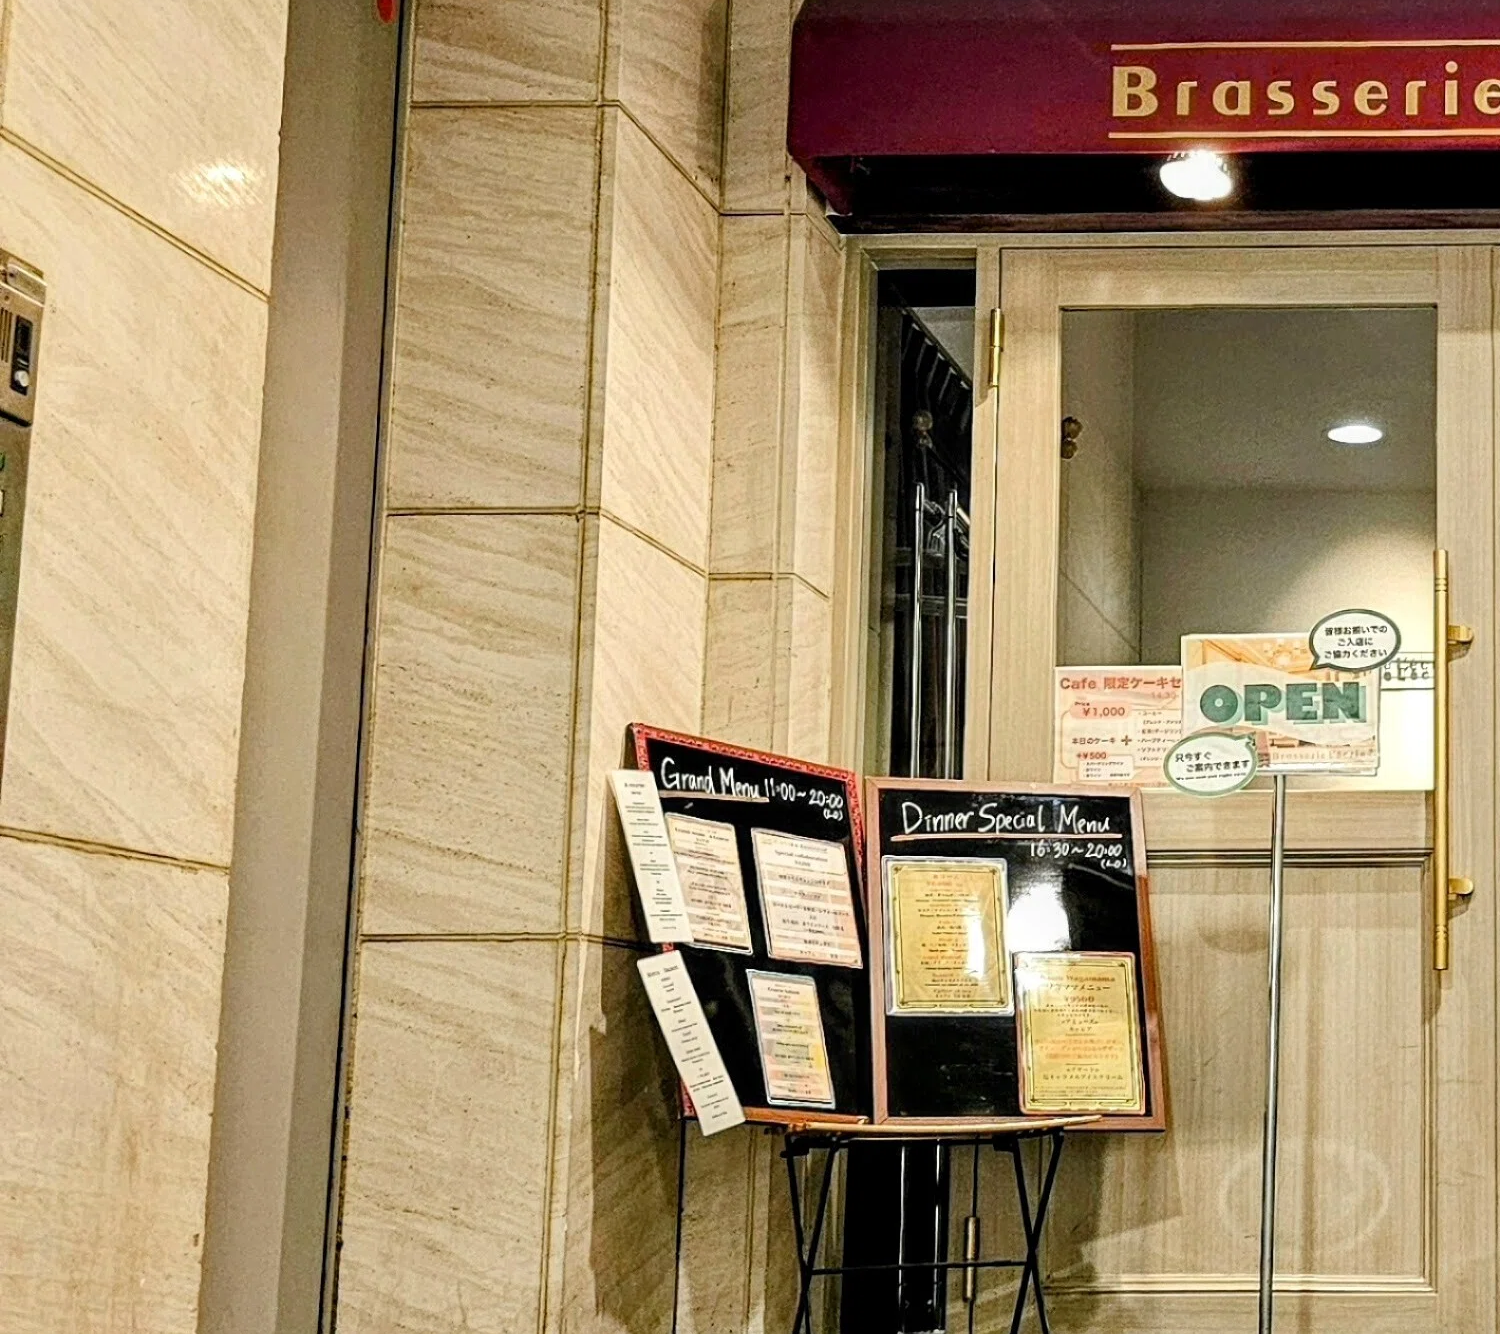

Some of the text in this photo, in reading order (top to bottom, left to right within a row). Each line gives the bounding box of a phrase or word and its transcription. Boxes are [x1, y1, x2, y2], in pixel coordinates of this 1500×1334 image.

[1337, 637, 1374, 647] ご入店に
[1324, 648, 1388, 659] ご協力ください
[1060, 677, 1097, 690] Cafe
[1200, 681, 1366, 725] OPEN
[1083, 706, 1126, 718] ¥1,000
[1072, 737, 1116, 745] 本日のケーキ
[661, 756, 716, 796] Grand
[719, 766, 760, 798] Menu
[901, 801, 1110, 836] Dinner Special Menu
